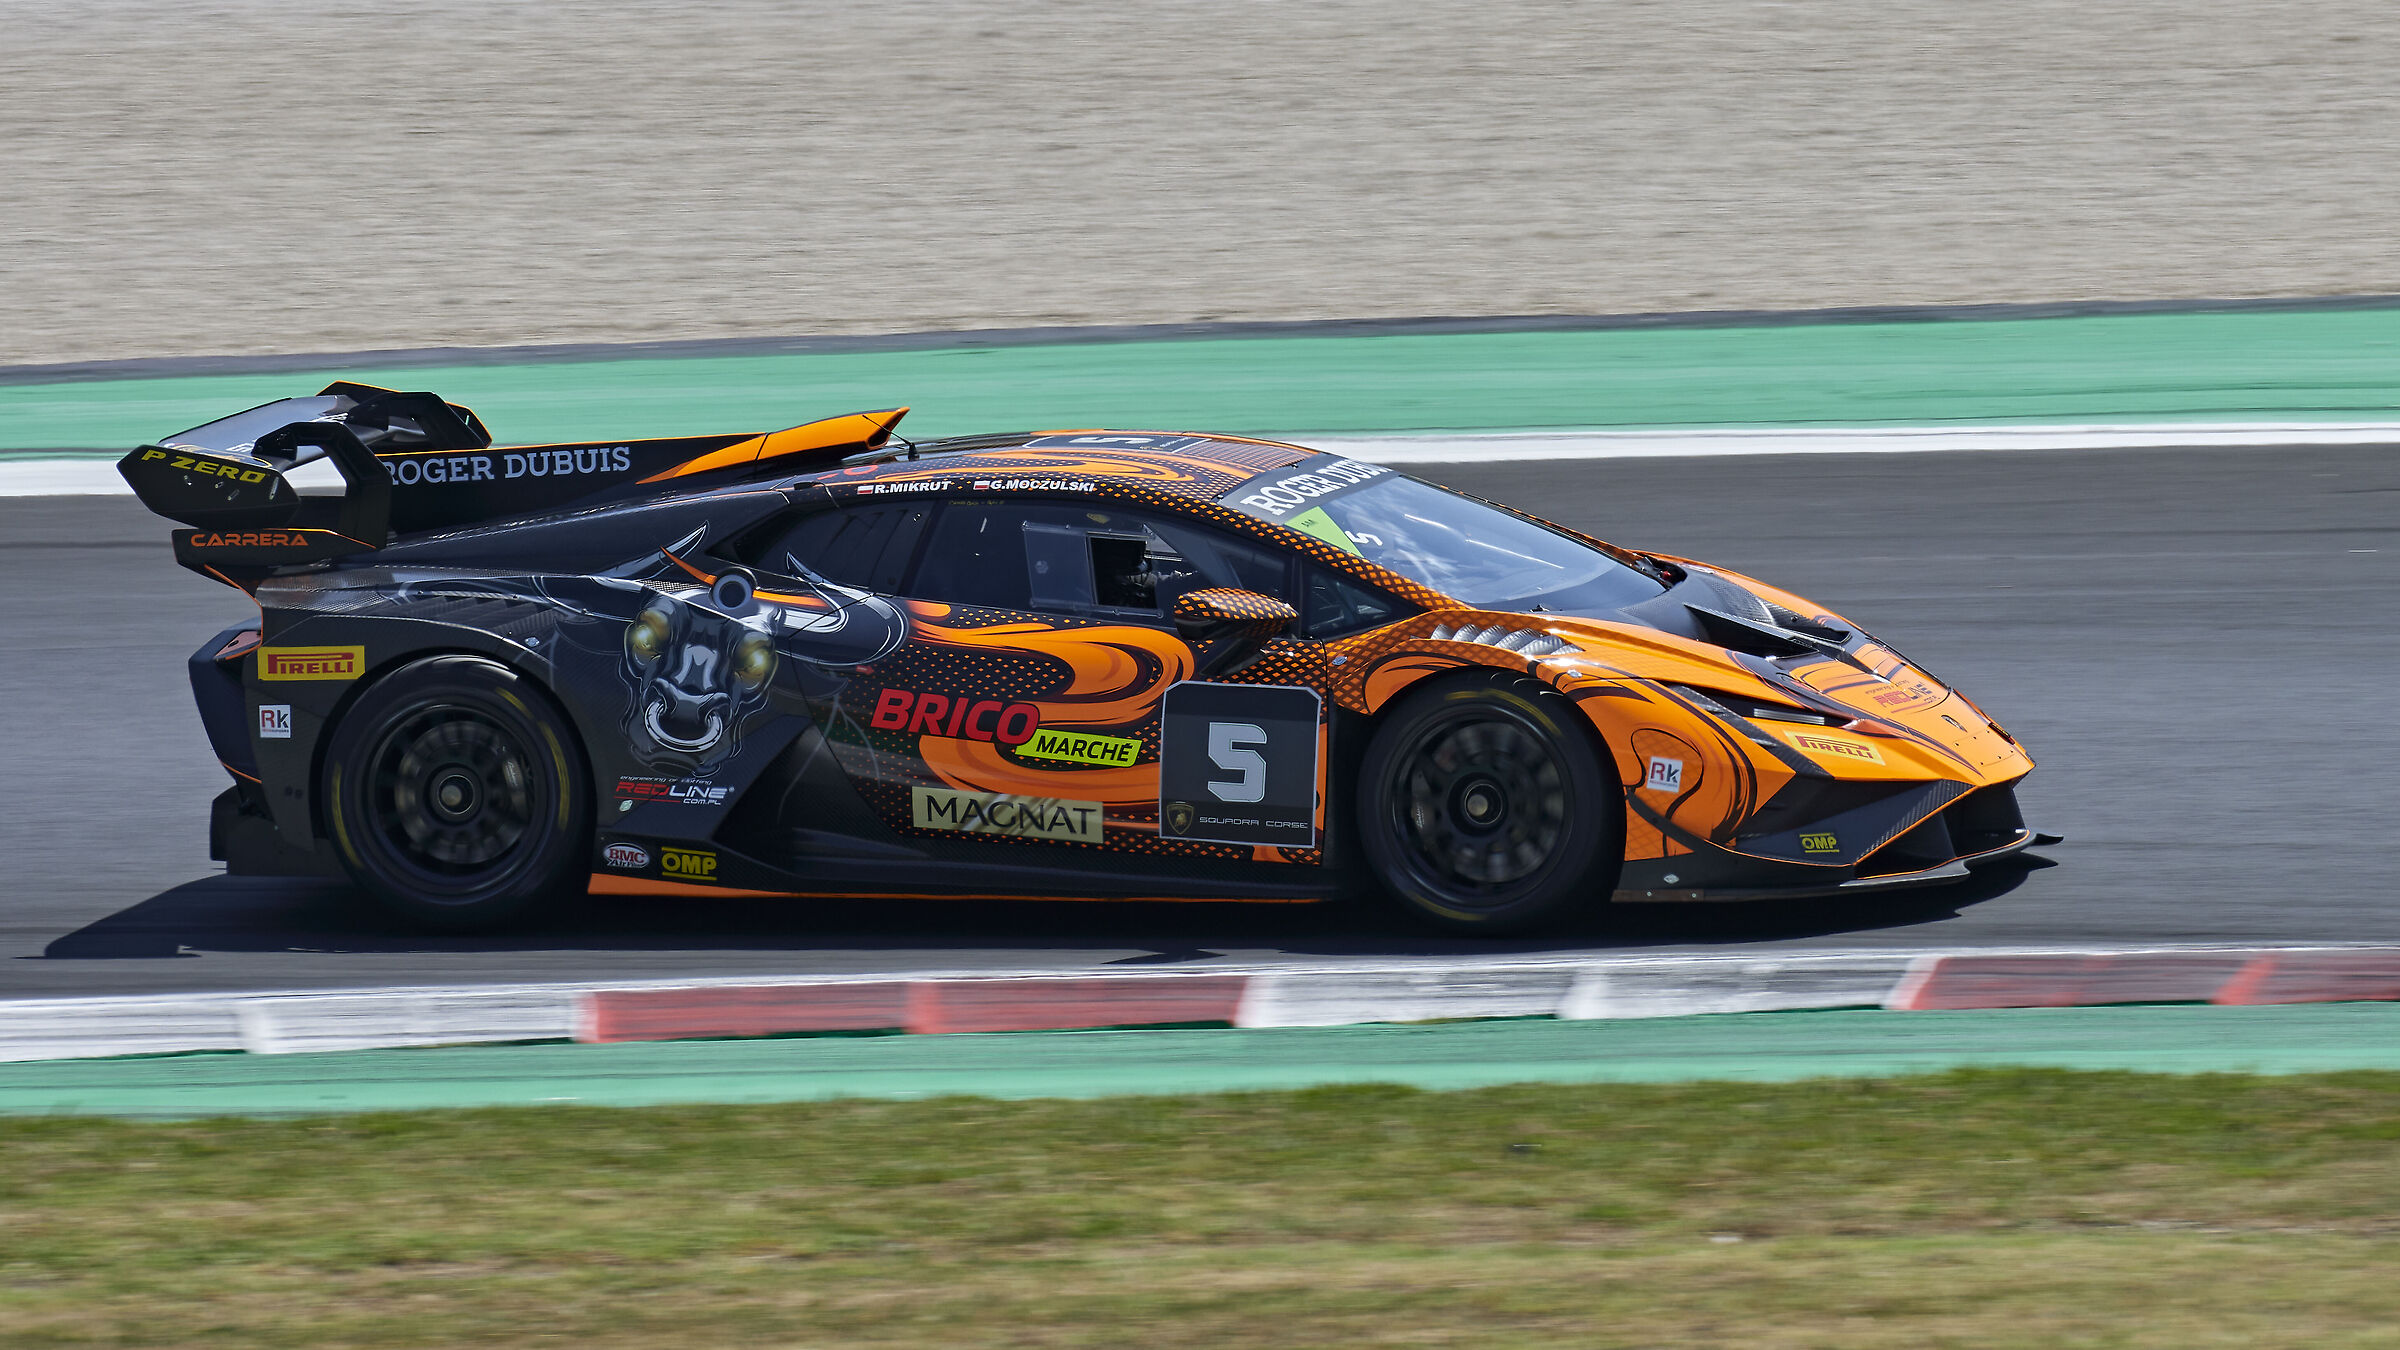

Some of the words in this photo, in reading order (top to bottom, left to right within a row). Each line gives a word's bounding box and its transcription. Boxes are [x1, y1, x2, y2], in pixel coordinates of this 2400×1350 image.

[141, 449, 167, 461] P
[170, 455, 267, 484] ZERO
[504, 446, 632, 479] DUBUIS
[874, 480, 951, 494] R.MIKRUT
[990, 479, 1095, 493] G.MOCZULSKI
[1240, 473, 1348, 516] ROGER
[190, 533, 309, 547] CARRERA
[1344, 530, 1383, 546] 5
[267, 652, 355, 674] PIRELLI
[261, 709, 289, 728] Rk
[870, 688, 1040, 745] BRICO
[1035, 735, 1134, 762] MARCHÉ
[1795, 735, 1874, 759] PIRELLI
[1207, 721, 1267, 803] 5
[1650, 761, 1680, 784] Rk
[926, 794, 1097, 835] MAGNAT
[1199, 816, 1260, 826] SQUADRA
[1266, 820, 1308, 829] CORSE
[1801, 836, 1837, 849] OMP
[609, 848, 645, 864] BMC
[661, 852, 717, 875] OMP
